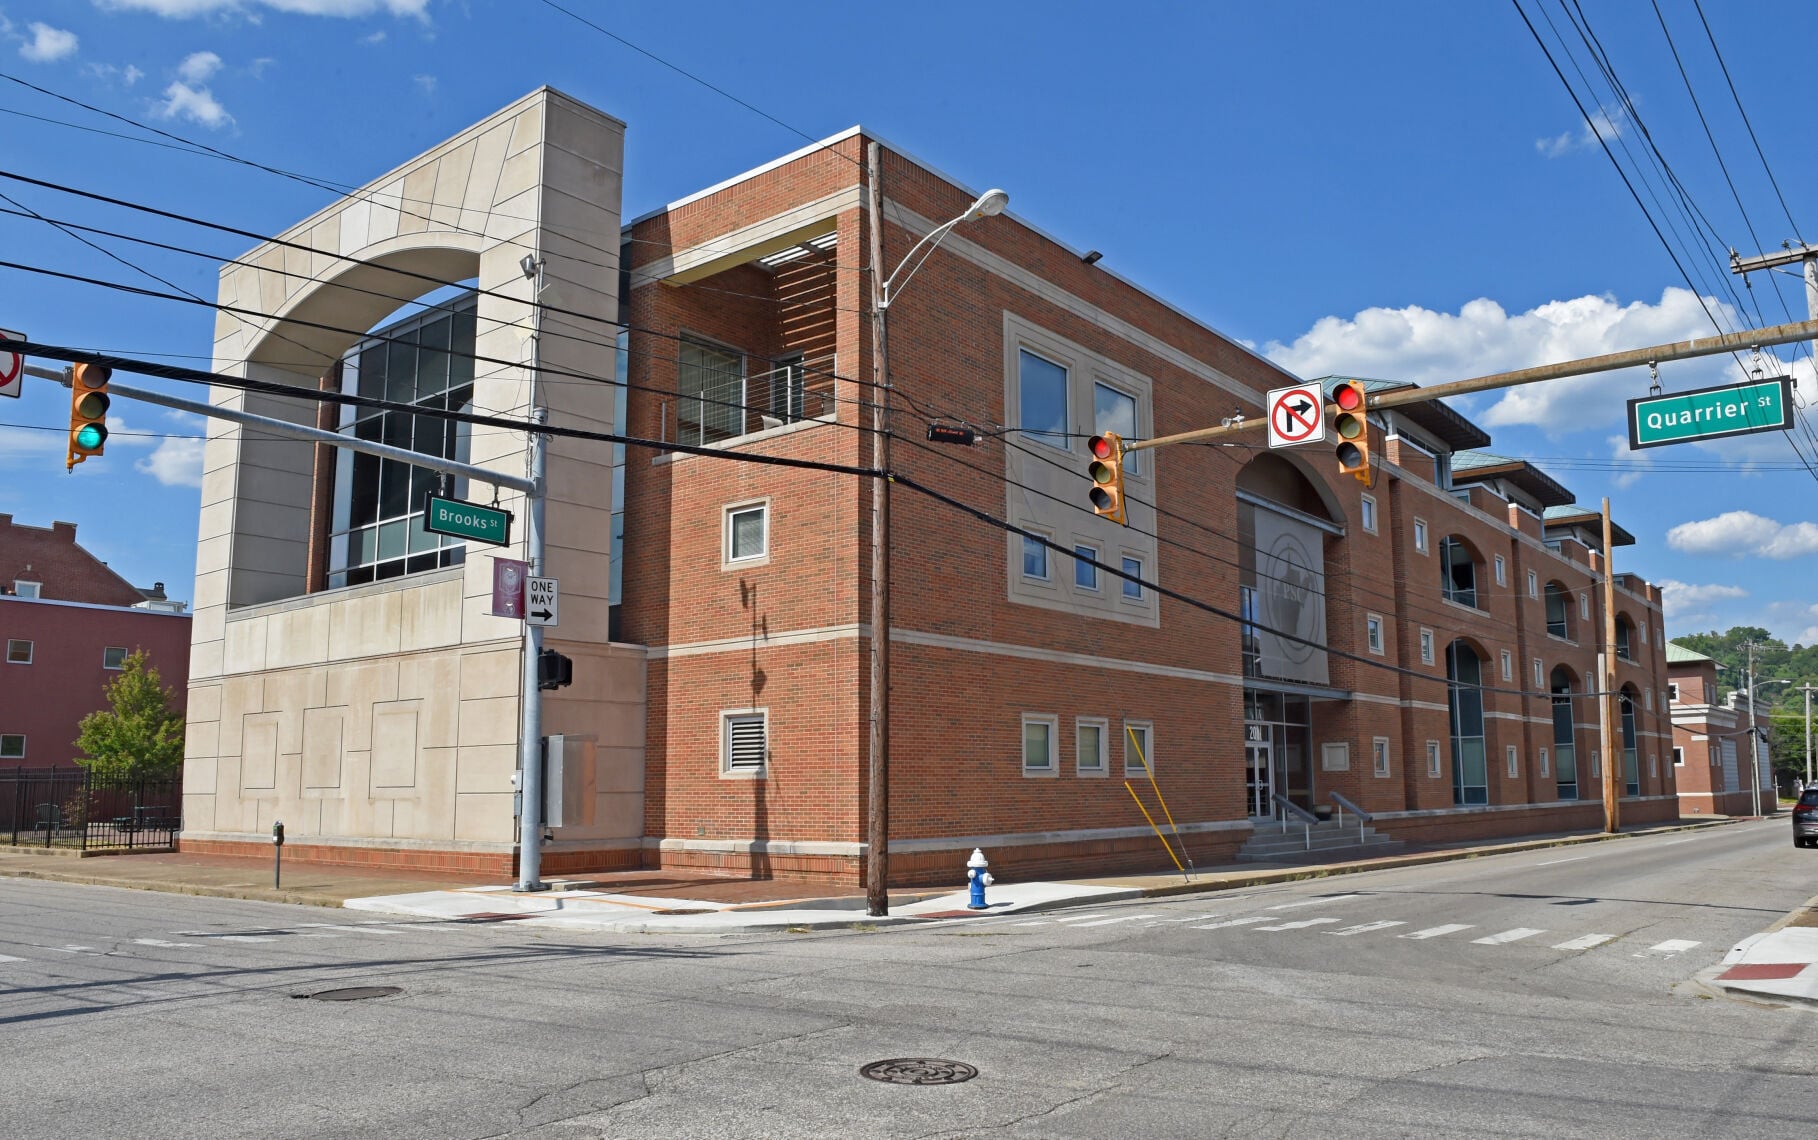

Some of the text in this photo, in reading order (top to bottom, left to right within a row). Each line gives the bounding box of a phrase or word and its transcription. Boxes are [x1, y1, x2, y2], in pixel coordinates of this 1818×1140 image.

[1647, 396, 1771, 430] Quarrier St
[439, 508, 498, 529] Brooks St
[531, 580, 553, 593] ONE
[530, 594, 554, 606] WAY
